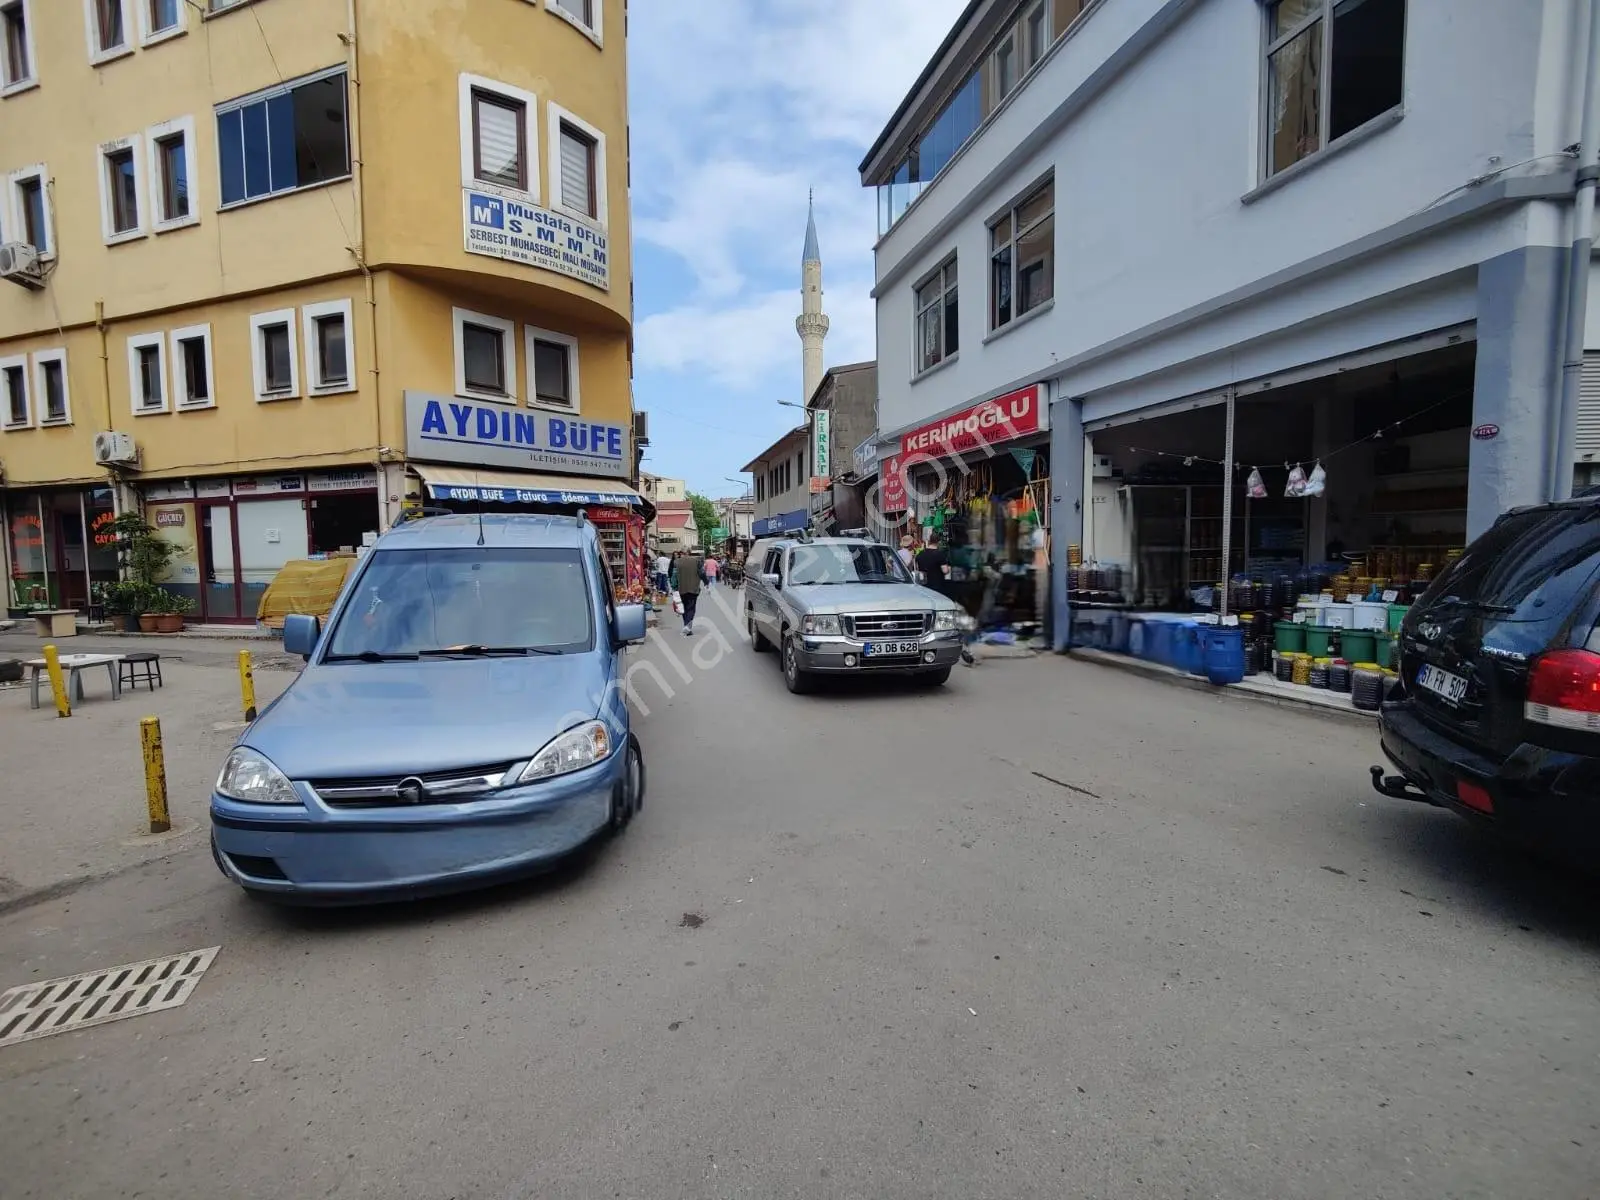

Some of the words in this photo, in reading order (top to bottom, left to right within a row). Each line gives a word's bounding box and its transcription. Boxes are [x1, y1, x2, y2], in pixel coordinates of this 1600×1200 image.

[507, 202, 571, 234] Mustafa
[576, 226, 606, 249] OFLU
[470, 228, 508, 246] SERBEST
[510, 236, 561, 260] MUHASEBECİ
[562, 251, 580, 267] MALİ
[421, 400, 535, 445] AYDIN
[906, 396, 1030, 452] KERİMOĞLU
[450, 488, 478, 500] AYDIN
[516, 490, 548, 502] Fatura
[870, 643, 882, 653] 53
[885, 643, 898, 653] DB
[900, 642, 918, 652] 628
